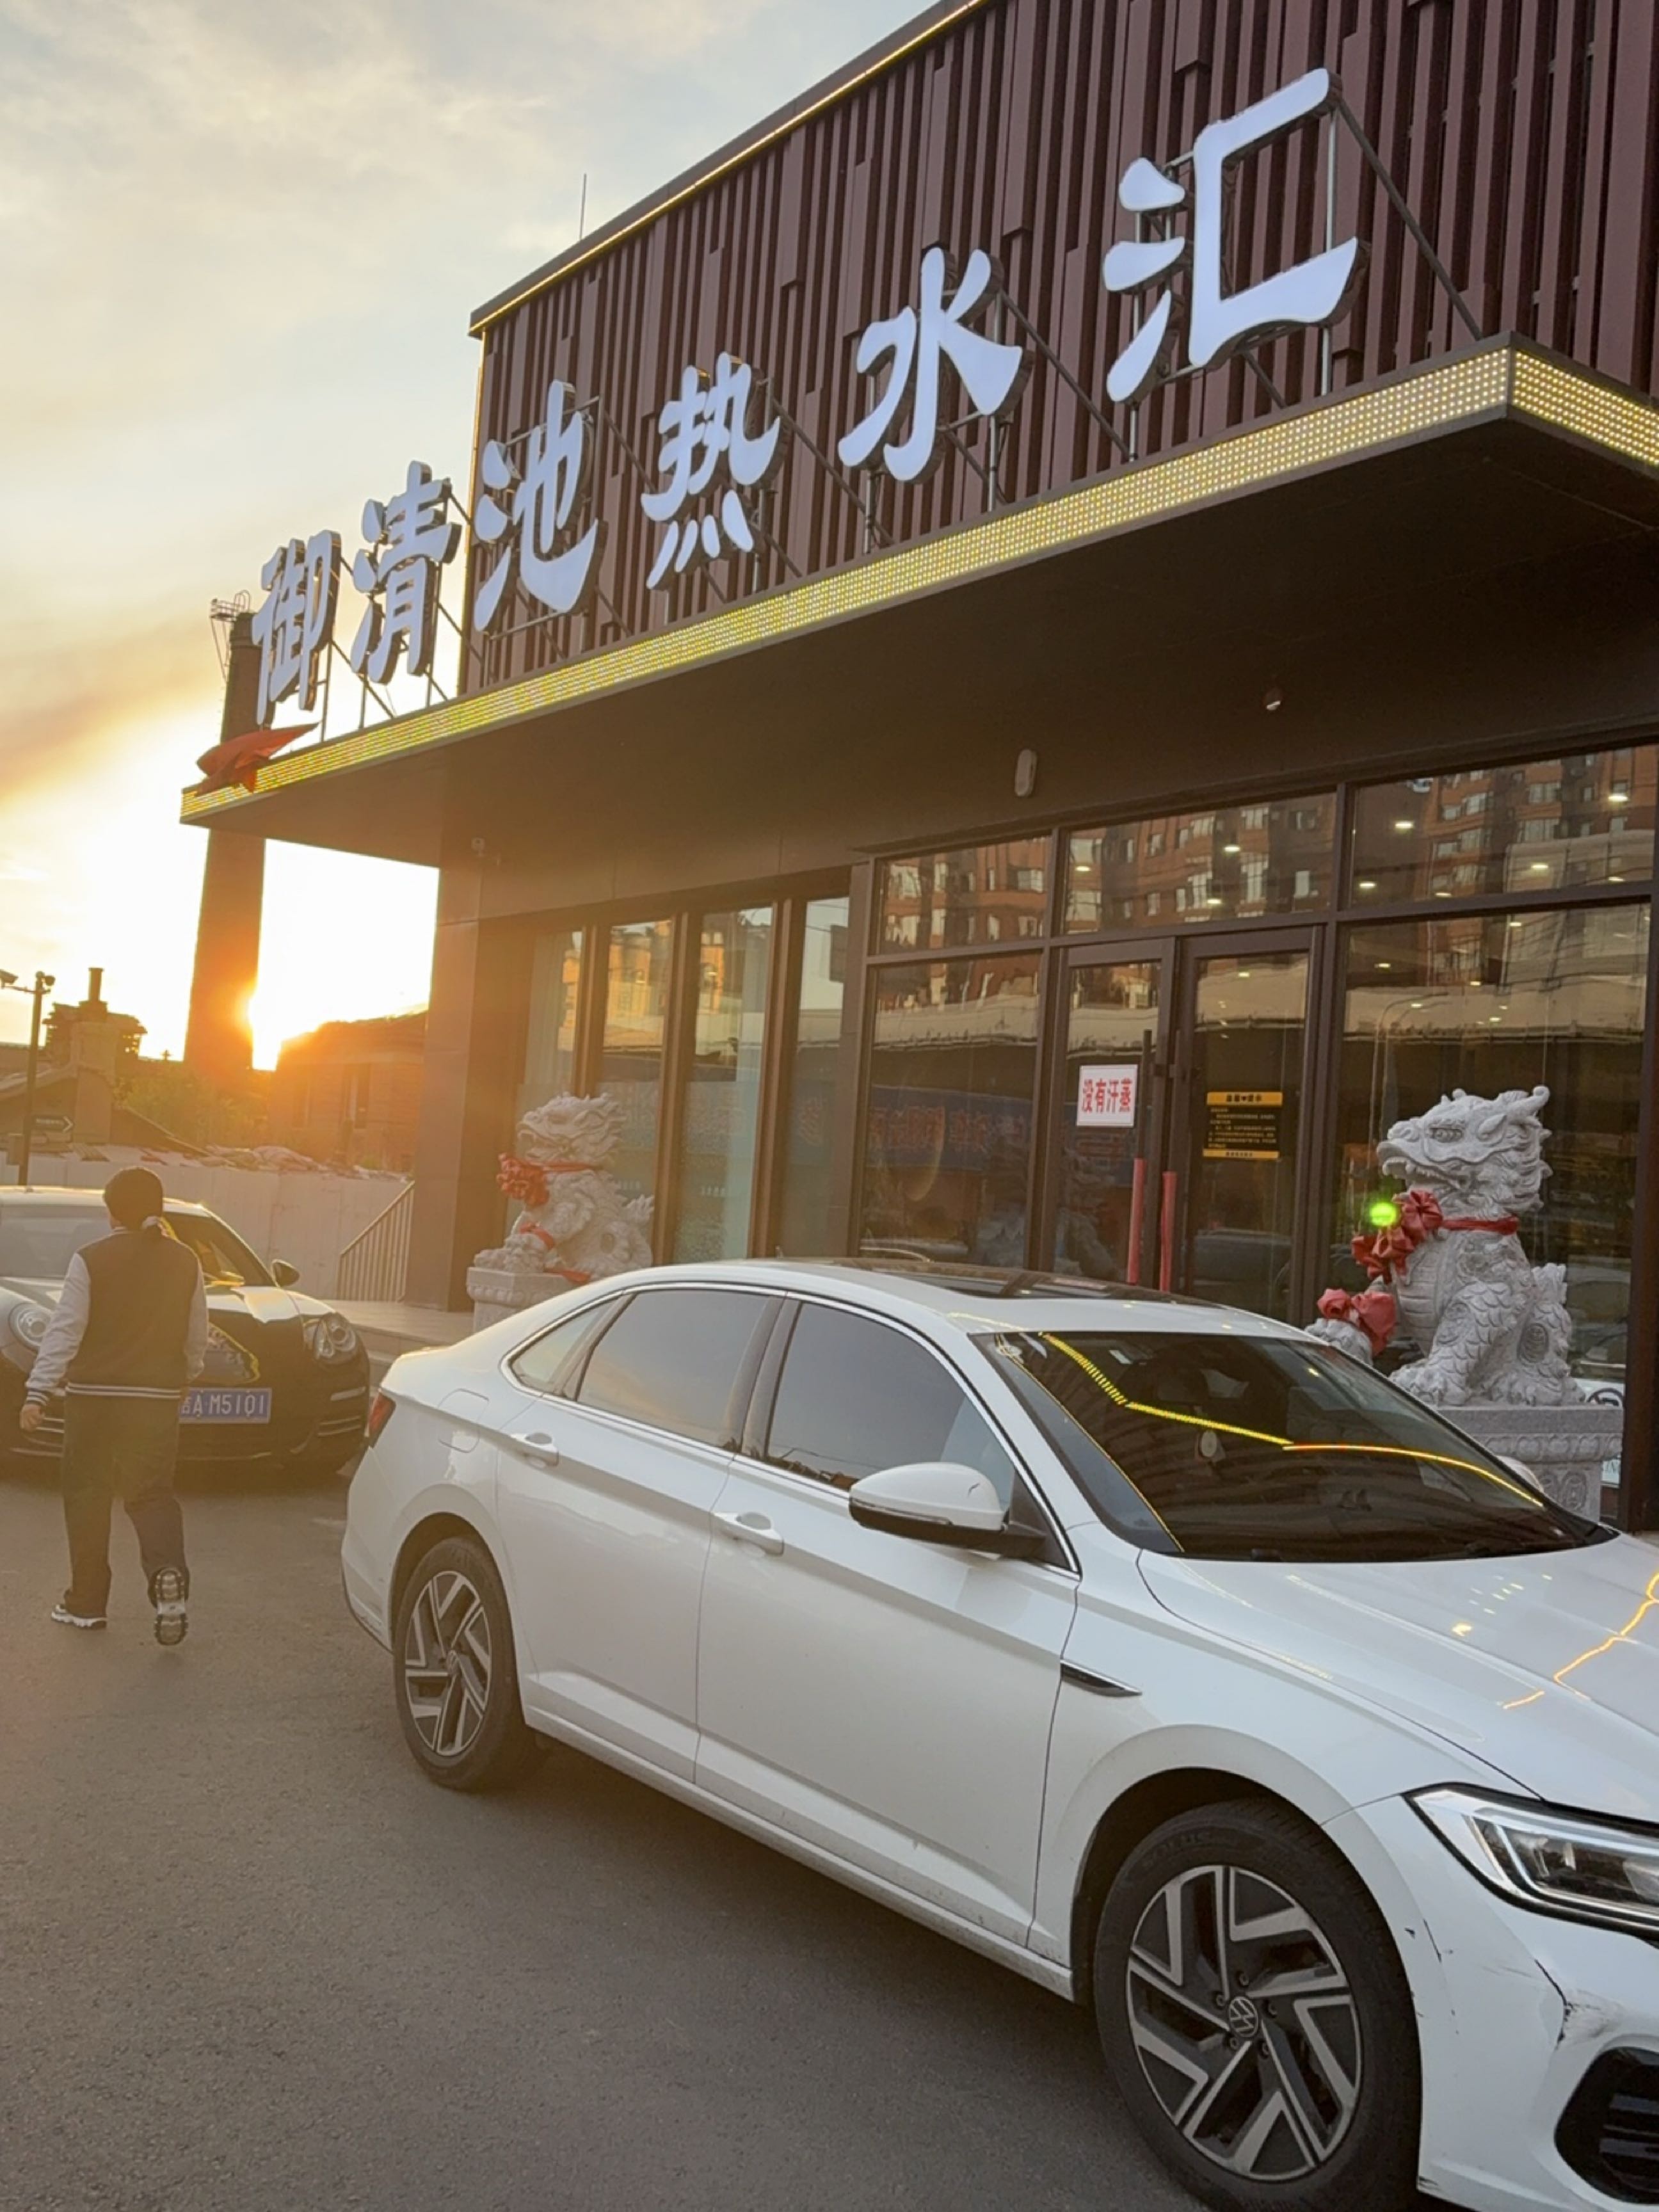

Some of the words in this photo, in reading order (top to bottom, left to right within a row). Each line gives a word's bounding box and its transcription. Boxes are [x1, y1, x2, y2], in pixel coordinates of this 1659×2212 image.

[252, 68, 1362, 725] 御清池热水汇
